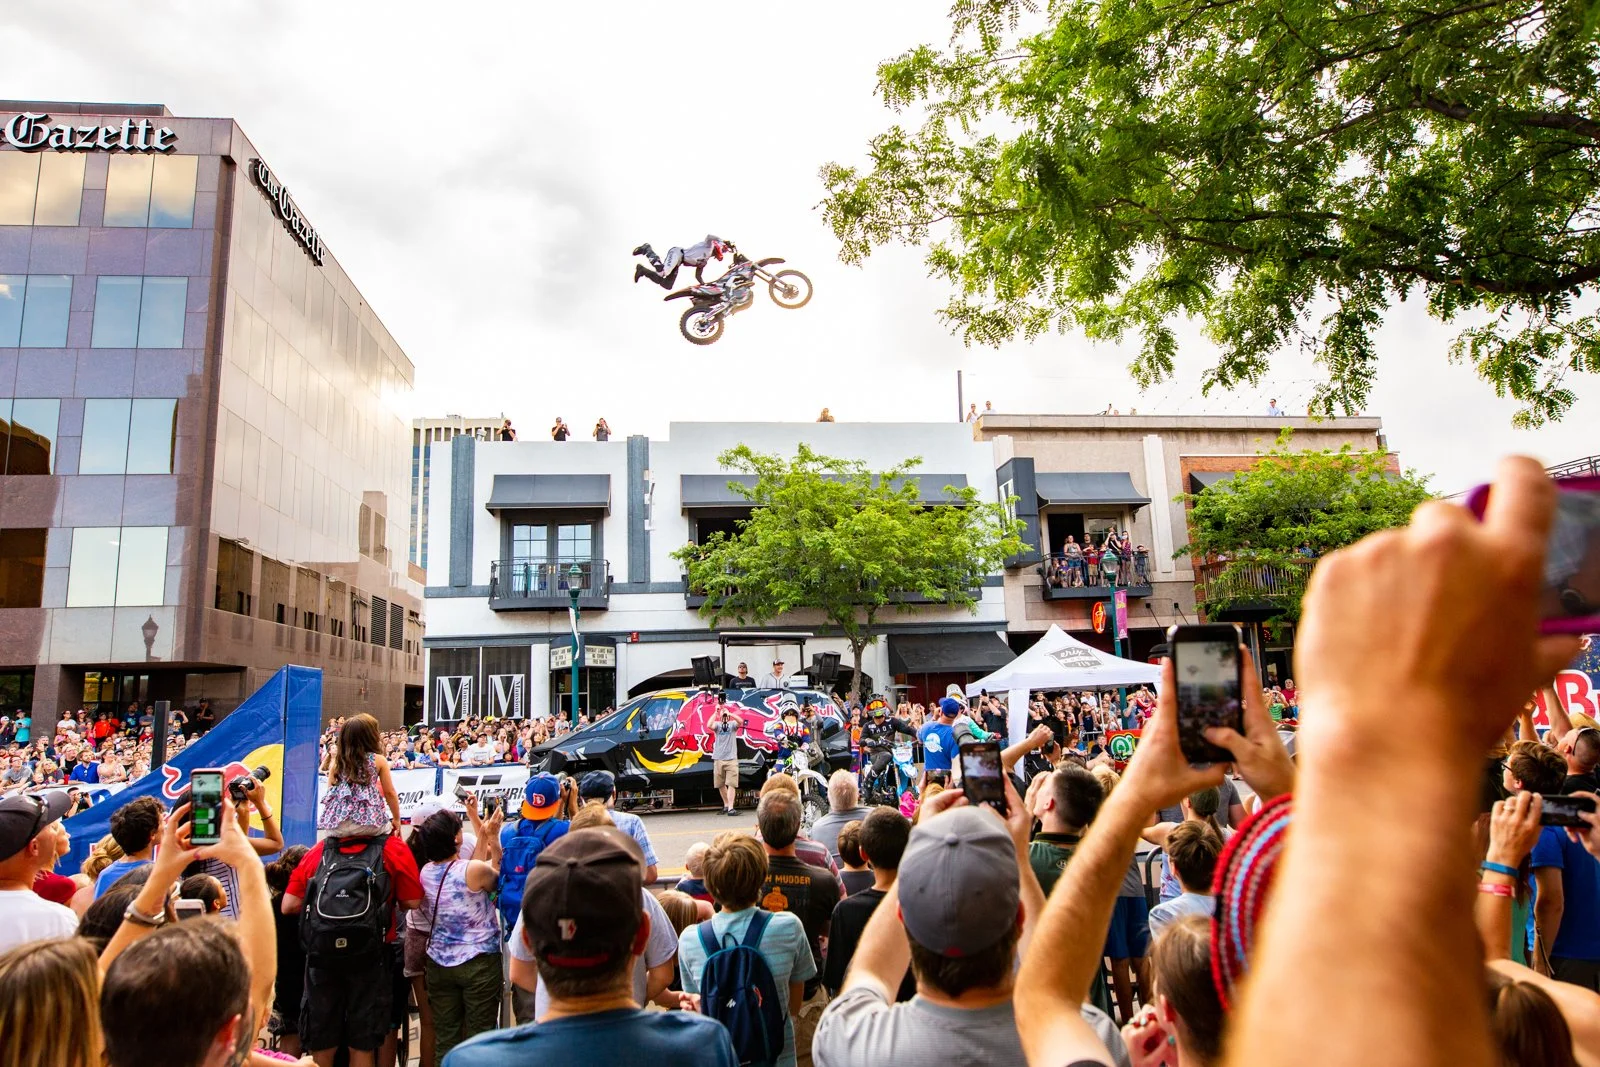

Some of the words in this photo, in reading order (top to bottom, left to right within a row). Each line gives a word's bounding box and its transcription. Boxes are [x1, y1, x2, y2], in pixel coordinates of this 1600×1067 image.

[4, 111, 178, 151] Gazette
[258, 159, 280, 201] The
[279, 184, 327, 267] Gazette
[775, 874, 811, 886] MUDDER
